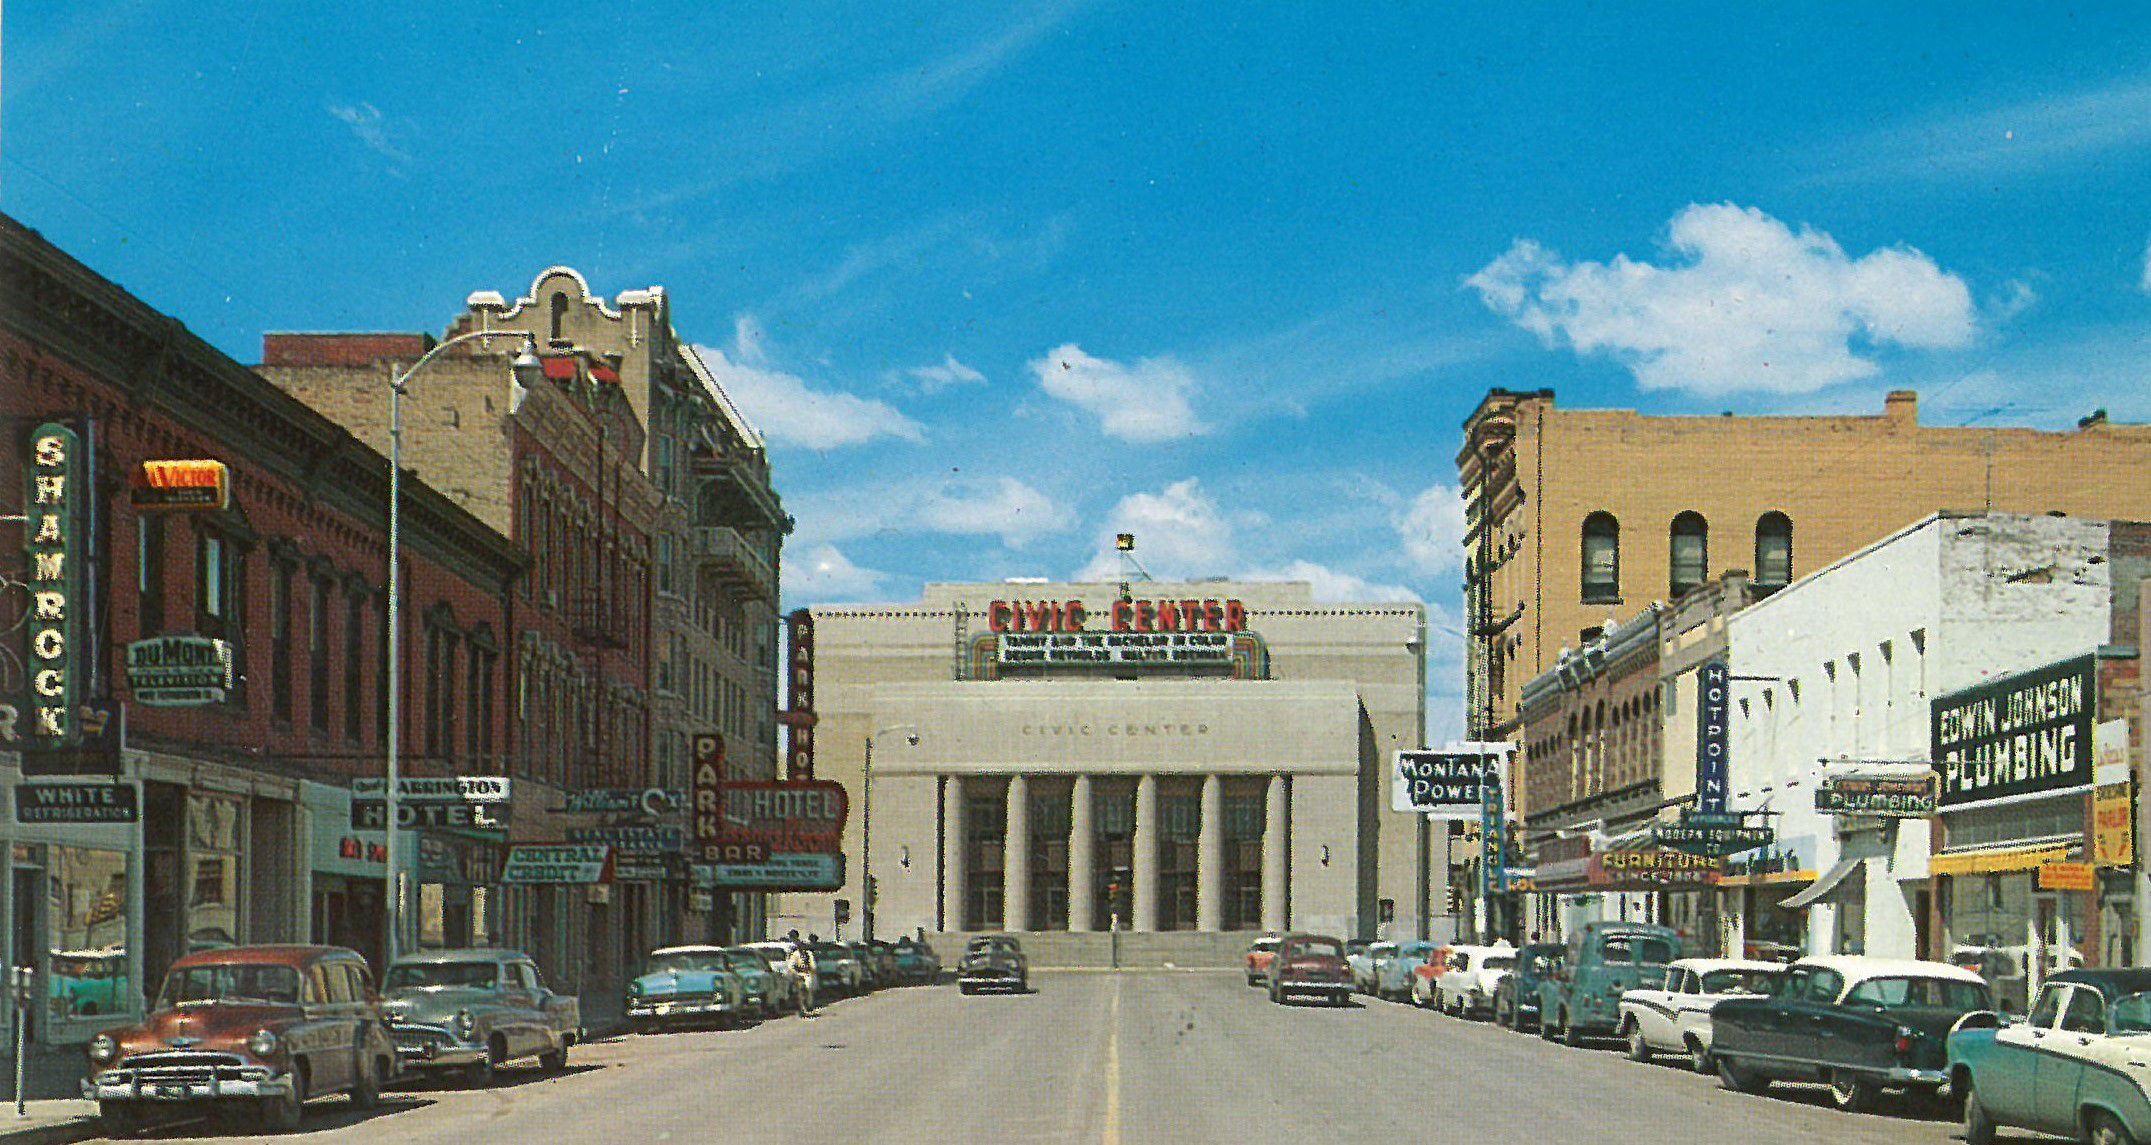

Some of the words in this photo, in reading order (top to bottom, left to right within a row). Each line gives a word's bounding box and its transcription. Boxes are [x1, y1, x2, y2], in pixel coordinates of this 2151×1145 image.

[157, 466, 217, 488] VICTOR
[34, 436, 67, 736] SHAMROCK
[988, 600, 1087, 632] CIVIC
[1111, 600, 1247, 632] CENTER
[1939, 697, 1997, 746] EDWIN
[2001, 673, 2083, 733] JOHNSON
[1021, 724, 1092, 736] CIVIC
[1107, 724, 1210, 736] CENTER
[1707, 668, 1723, 812] HOTPOINT
[1400, 757, 1500, 778] MONTANA
[1946, 724, 2077, 794] PLUMBING
[35, 787, 115, 805] WHITE
[384, 777, 501, 794] ARRINGTON
[696, 737, 718, 839] PARK
[23, 806, 133, 819] REFRIGERATION
[755, 790, 838, 820] HOTEL
[362, 804, 497, 828] HOTEL
[1656, 827, 1704, 841] MODERN
[513, 847, 602, 862] CENTRAL
[704, 845, 763, 861] BAR
[1602, 851, 1721, 869] FURNITURE
[508, 864, 580, 880] CREDIT
